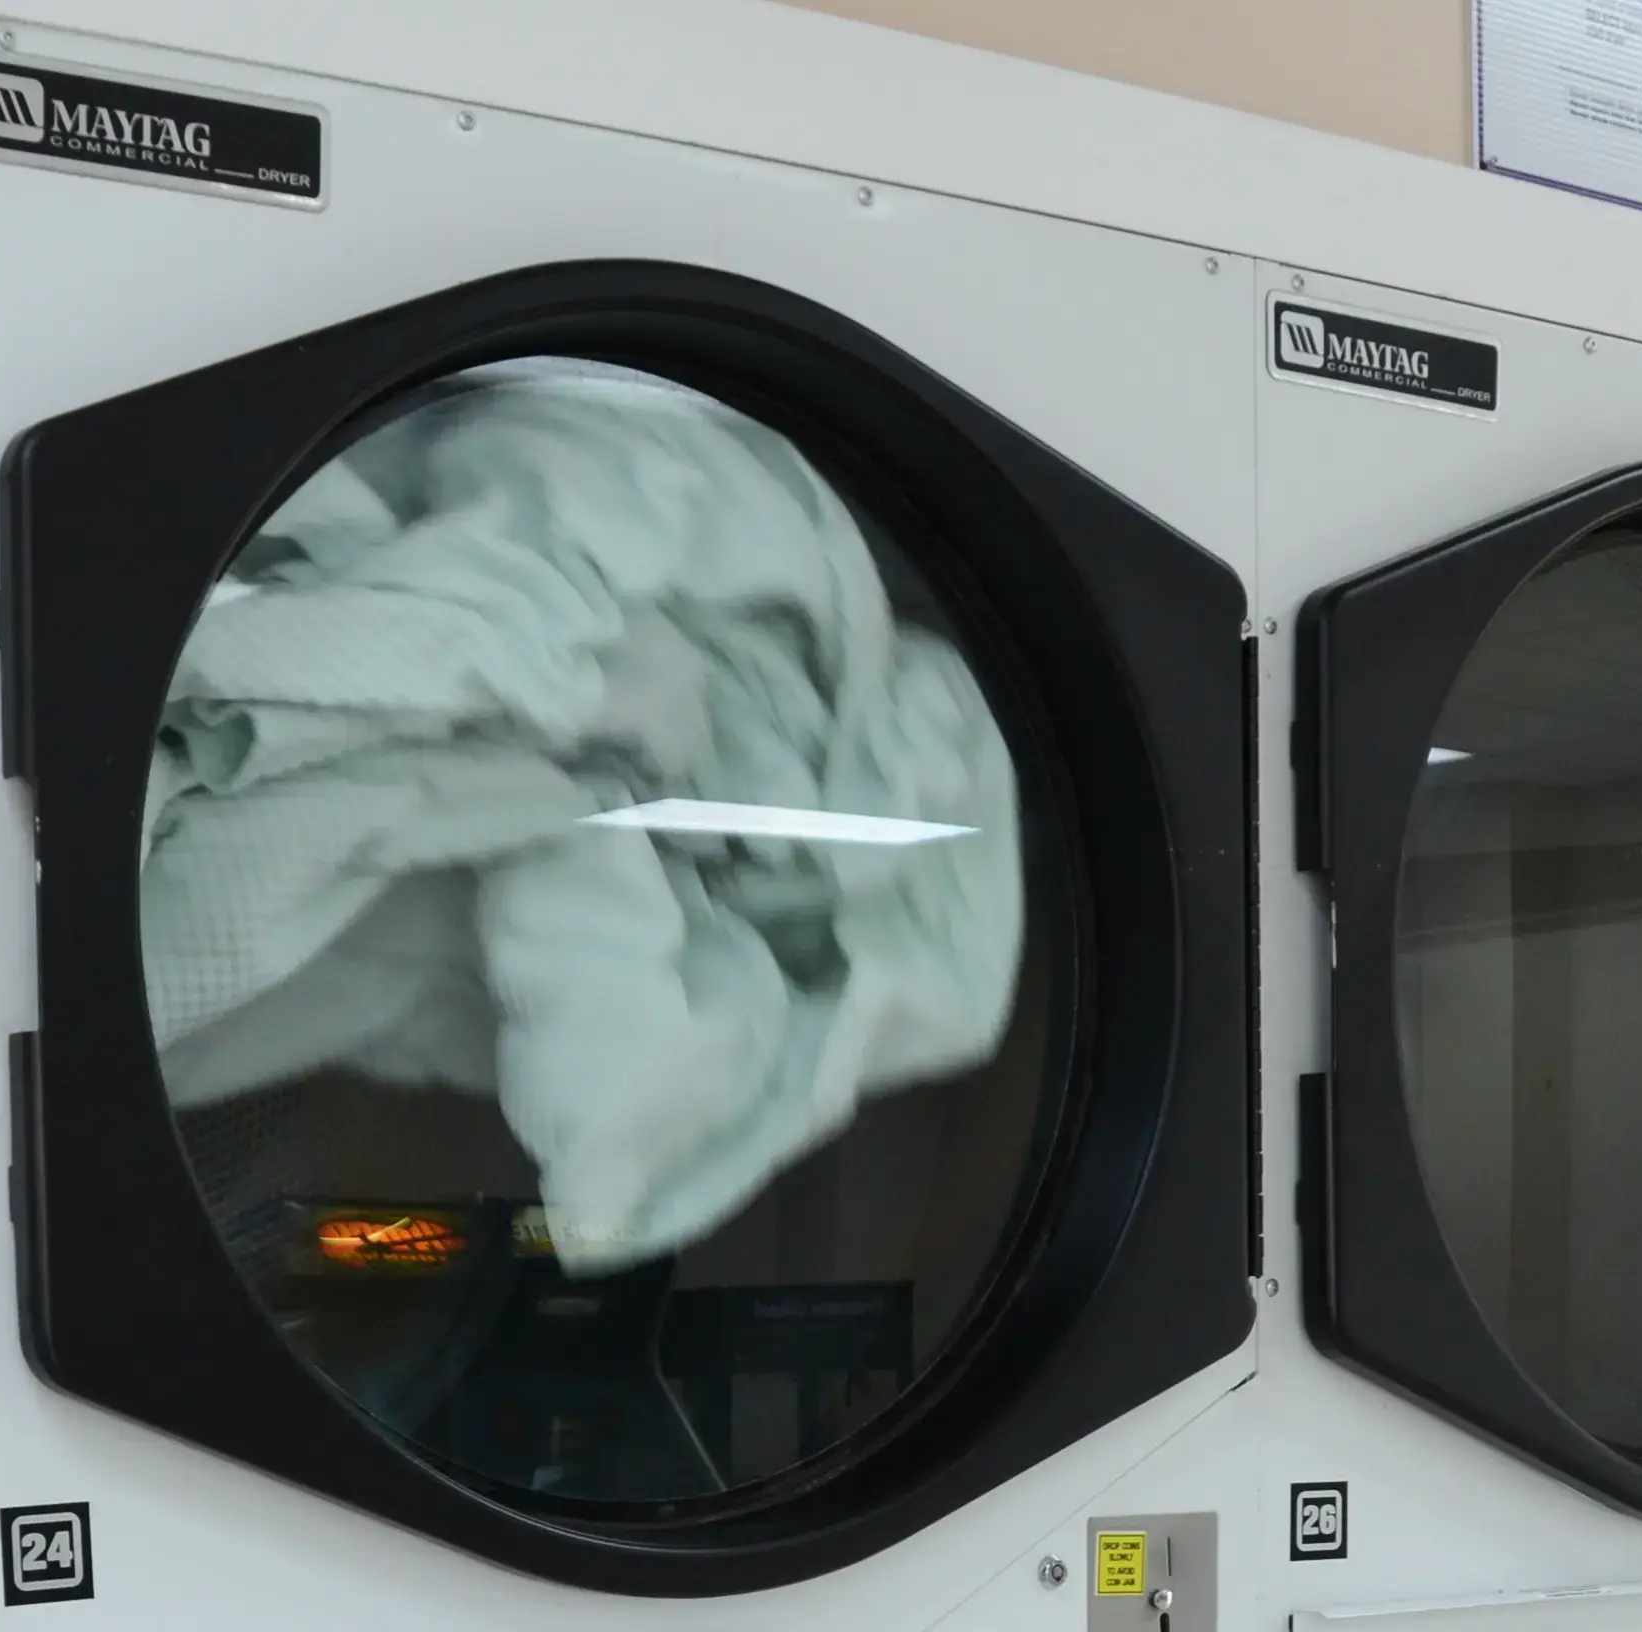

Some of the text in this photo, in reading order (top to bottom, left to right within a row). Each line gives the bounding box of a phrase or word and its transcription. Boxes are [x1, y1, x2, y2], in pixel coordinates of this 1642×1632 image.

[51, 98, 211, 157] MAYTAG
[50, 135, 311, 188] COMMERCIAL DRYER
[1327, 332, 1429, 379] MAYTAG
[1327, 362, 1491, 403] COMMERCIAL DRYER
[1303, 1503, 1337, 1535] 26
[21, 1530, 74, 1572] 24
